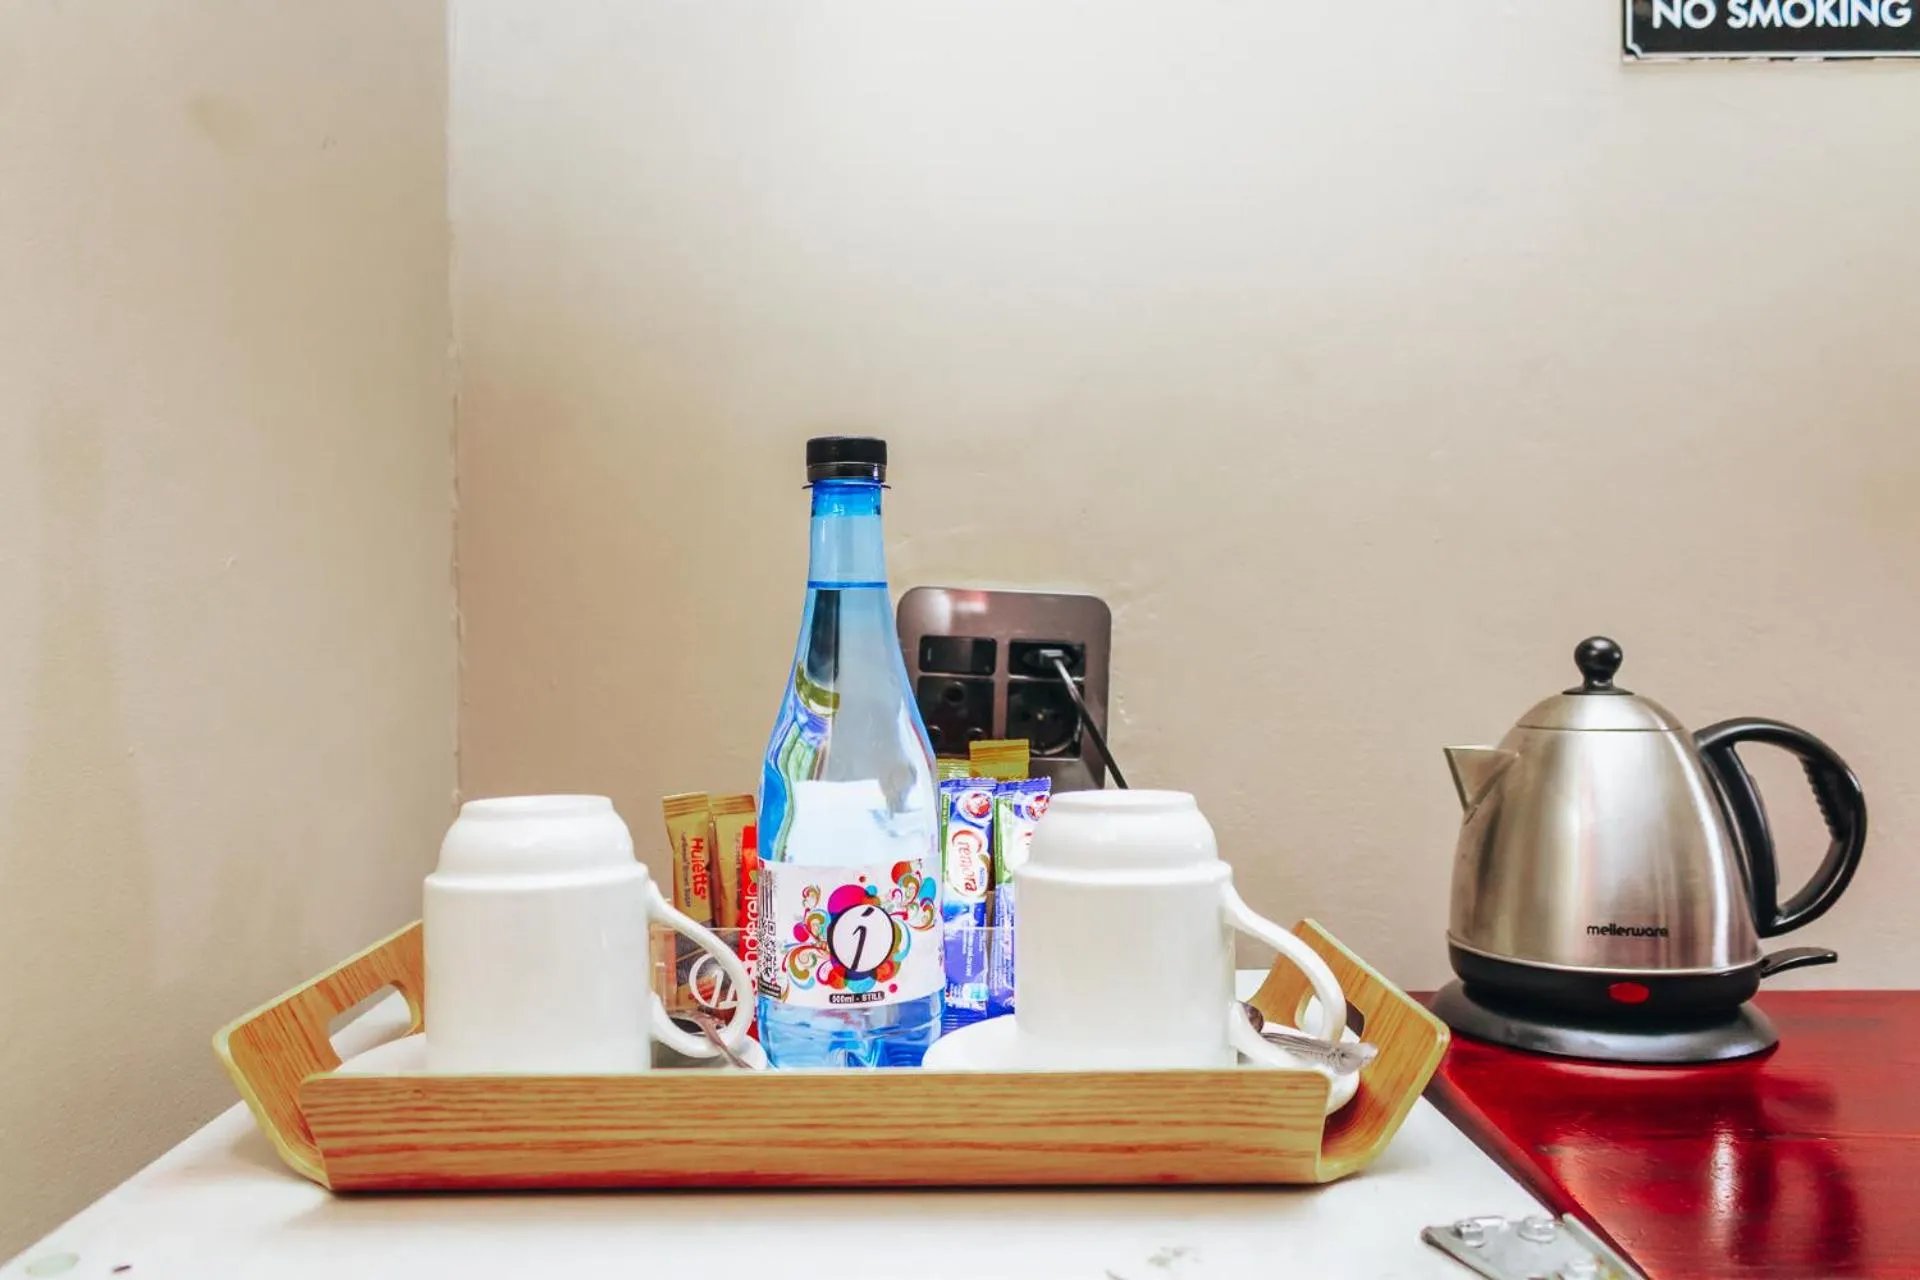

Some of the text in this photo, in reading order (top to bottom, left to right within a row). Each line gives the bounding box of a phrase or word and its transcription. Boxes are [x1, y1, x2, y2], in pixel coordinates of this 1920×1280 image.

[1652, 0, 1912, 28] NO SMOKING
[952, 830, 983, 892] Cremora
[1586, 922, 1669, 937] mellerware
